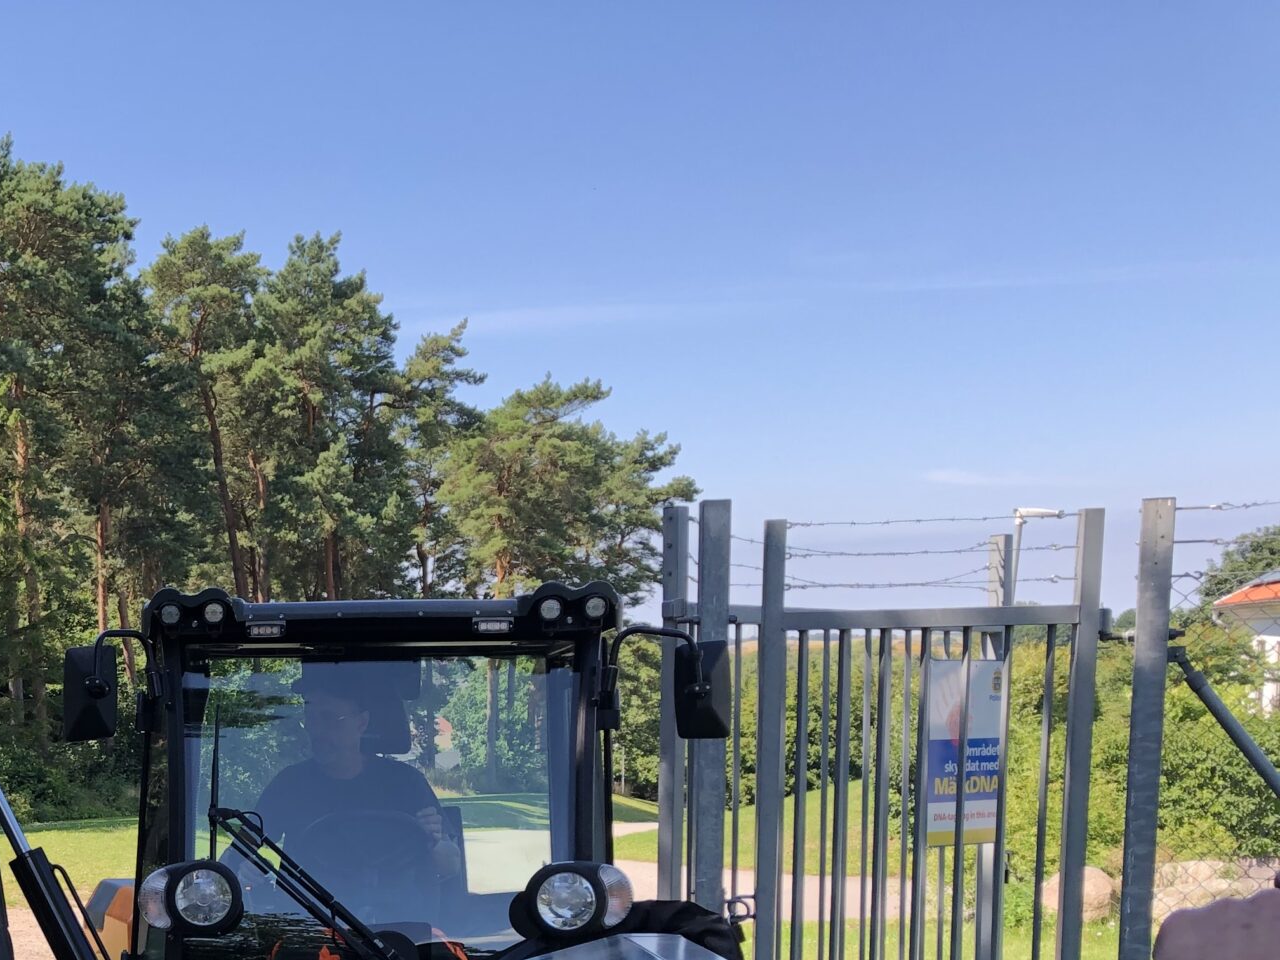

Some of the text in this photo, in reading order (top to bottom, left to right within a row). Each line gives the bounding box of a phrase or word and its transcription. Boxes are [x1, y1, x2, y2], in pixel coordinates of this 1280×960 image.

[944, 760, 999, 775] skydat med
[934, 776, 998, 795] MäDNA
